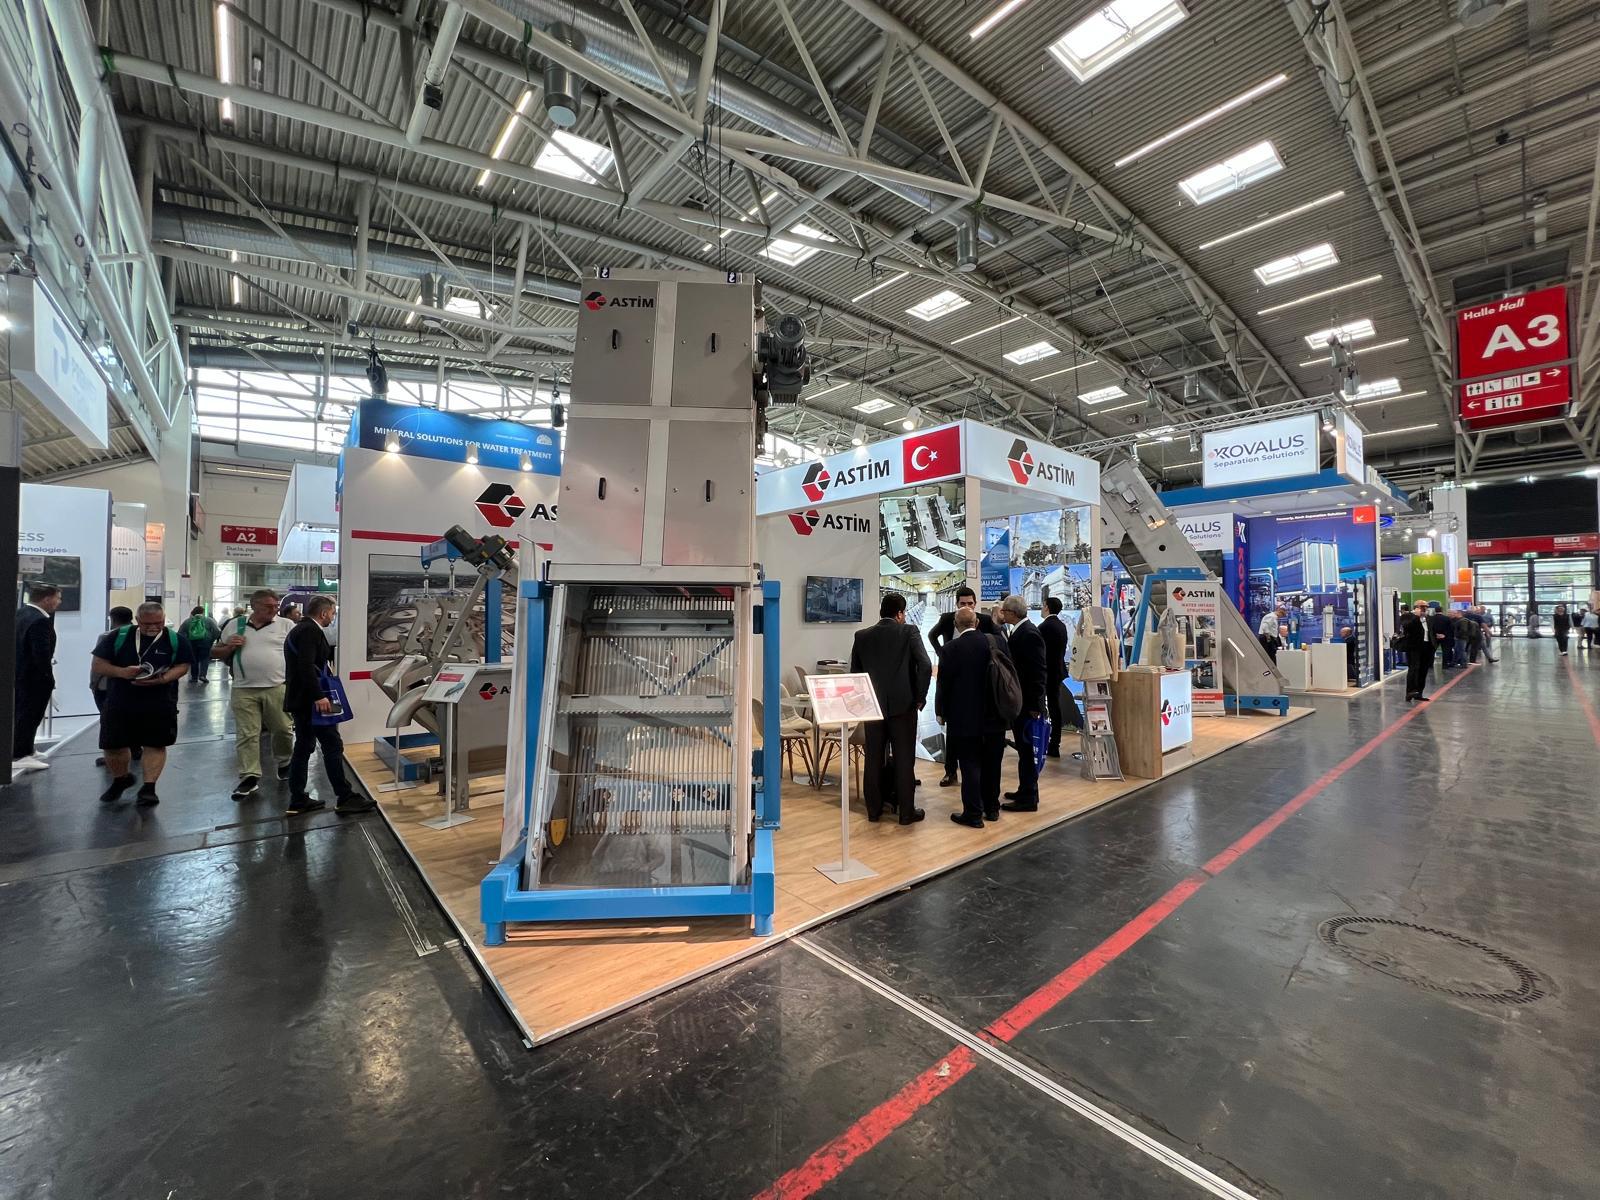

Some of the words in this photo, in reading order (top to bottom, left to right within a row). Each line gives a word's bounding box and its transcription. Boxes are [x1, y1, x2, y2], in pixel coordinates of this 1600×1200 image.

[609, 296, 654, 308] ASTİM
[1463, 307, 1496, 320] Halle
[1499, 298, 1525, 312] Hall
[1482, 314, 1561, 359] A3
[416, 432, 463, 446] SOLUTIONS
[482, 443, 509, 454] WATER
[511, 446, 553, 460] TREATMENT
[1214, 434, 1304, 460] KOVALUS
[834, 459, 890, 488] ASTİM
[1213, 456, 1260, 469] Separation
[1036, 463, 1075, 487] ASTİM
[823, 513, 871, 533] ASTİM
[236, 532, 257, 543] A2
